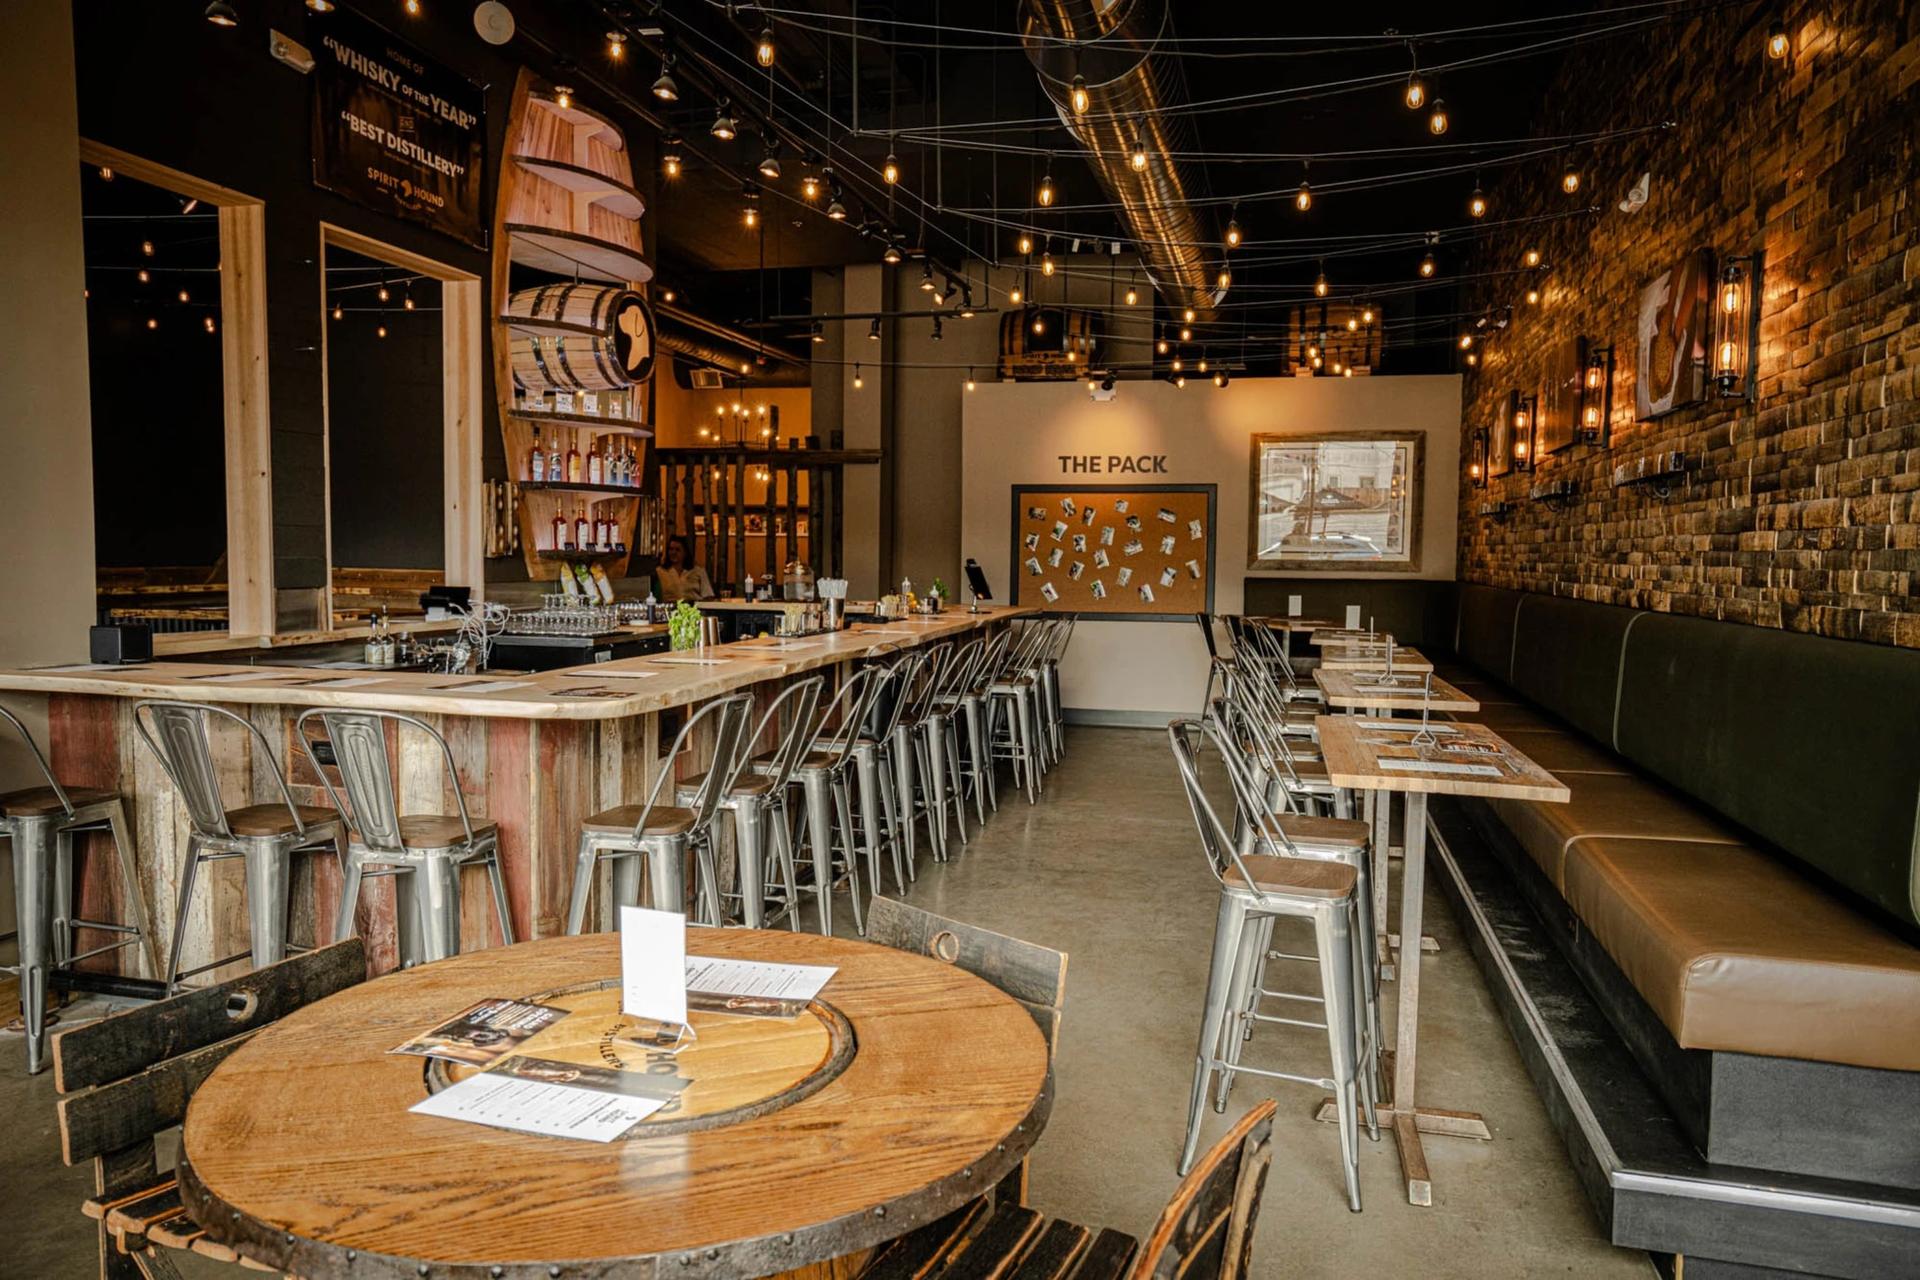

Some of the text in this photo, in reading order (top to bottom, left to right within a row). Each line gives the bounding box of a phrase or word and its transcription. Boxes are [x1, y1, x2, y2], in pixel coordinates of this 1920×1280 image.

[401, 84, 414, 97] OF
[414, 90, 430, 106] THE
[367, 167, 401, 189] SPIRIT
[413, 186, 445, 208] HOUND
[1058, 454, 1168, 474] THE PACK
